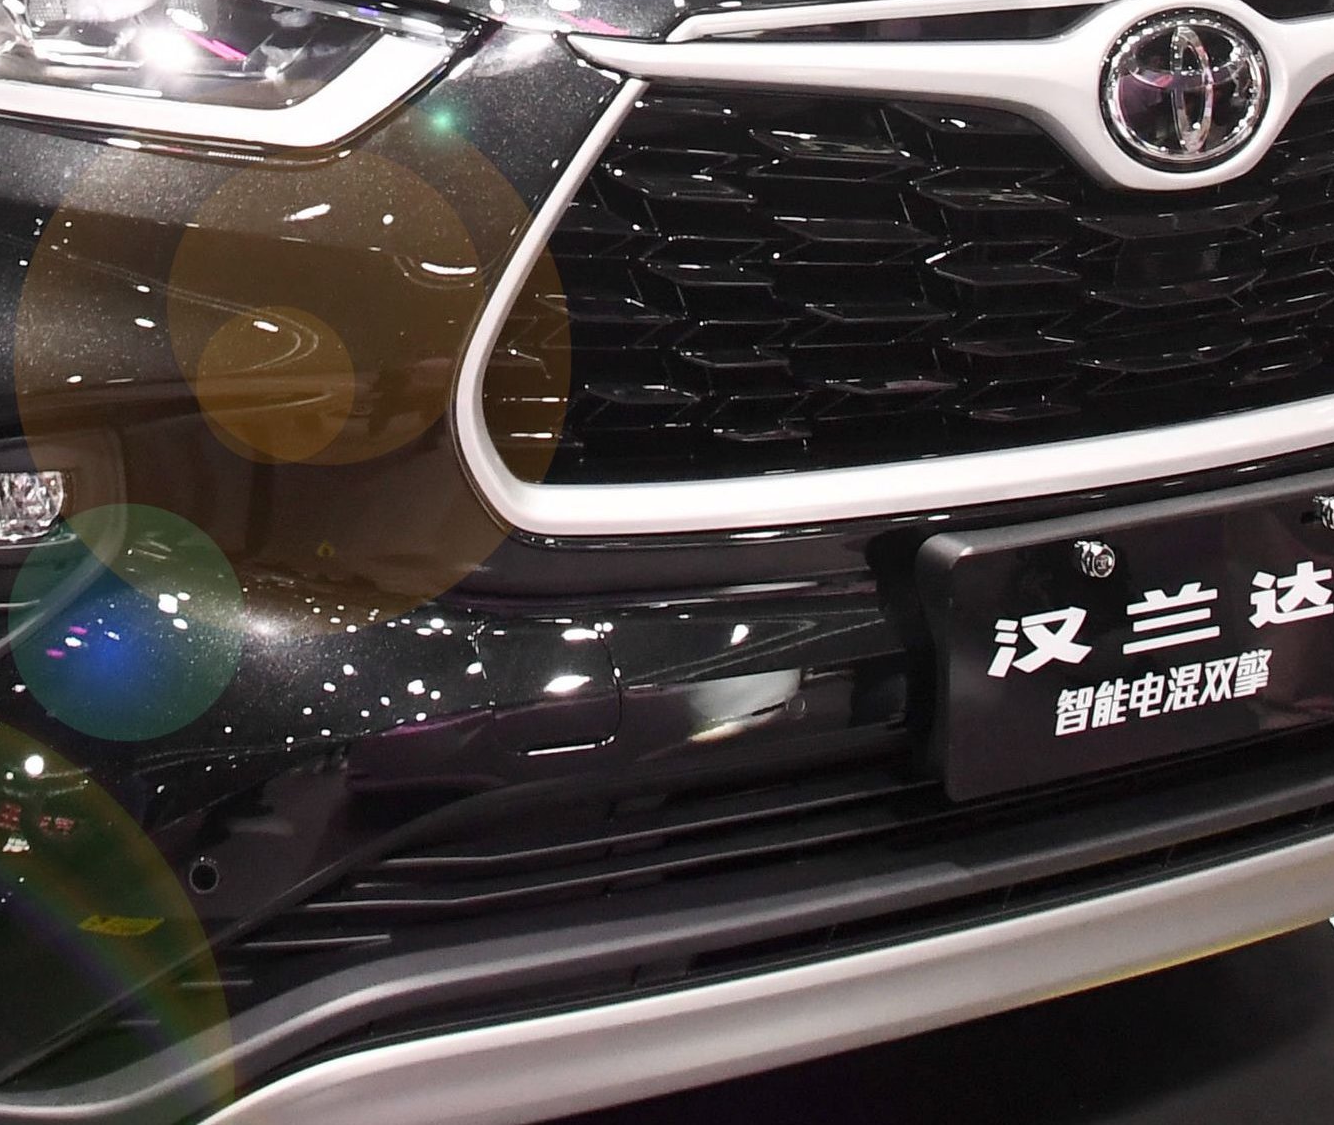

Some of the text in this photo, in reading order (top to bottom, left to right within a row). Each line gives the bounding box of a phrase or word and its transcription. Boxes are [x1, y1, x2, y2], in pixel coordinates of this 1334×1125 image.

[987, 561, 1334, 678] 汉兰达
[1054, 648, 1273, 737] 智能电混双擎
